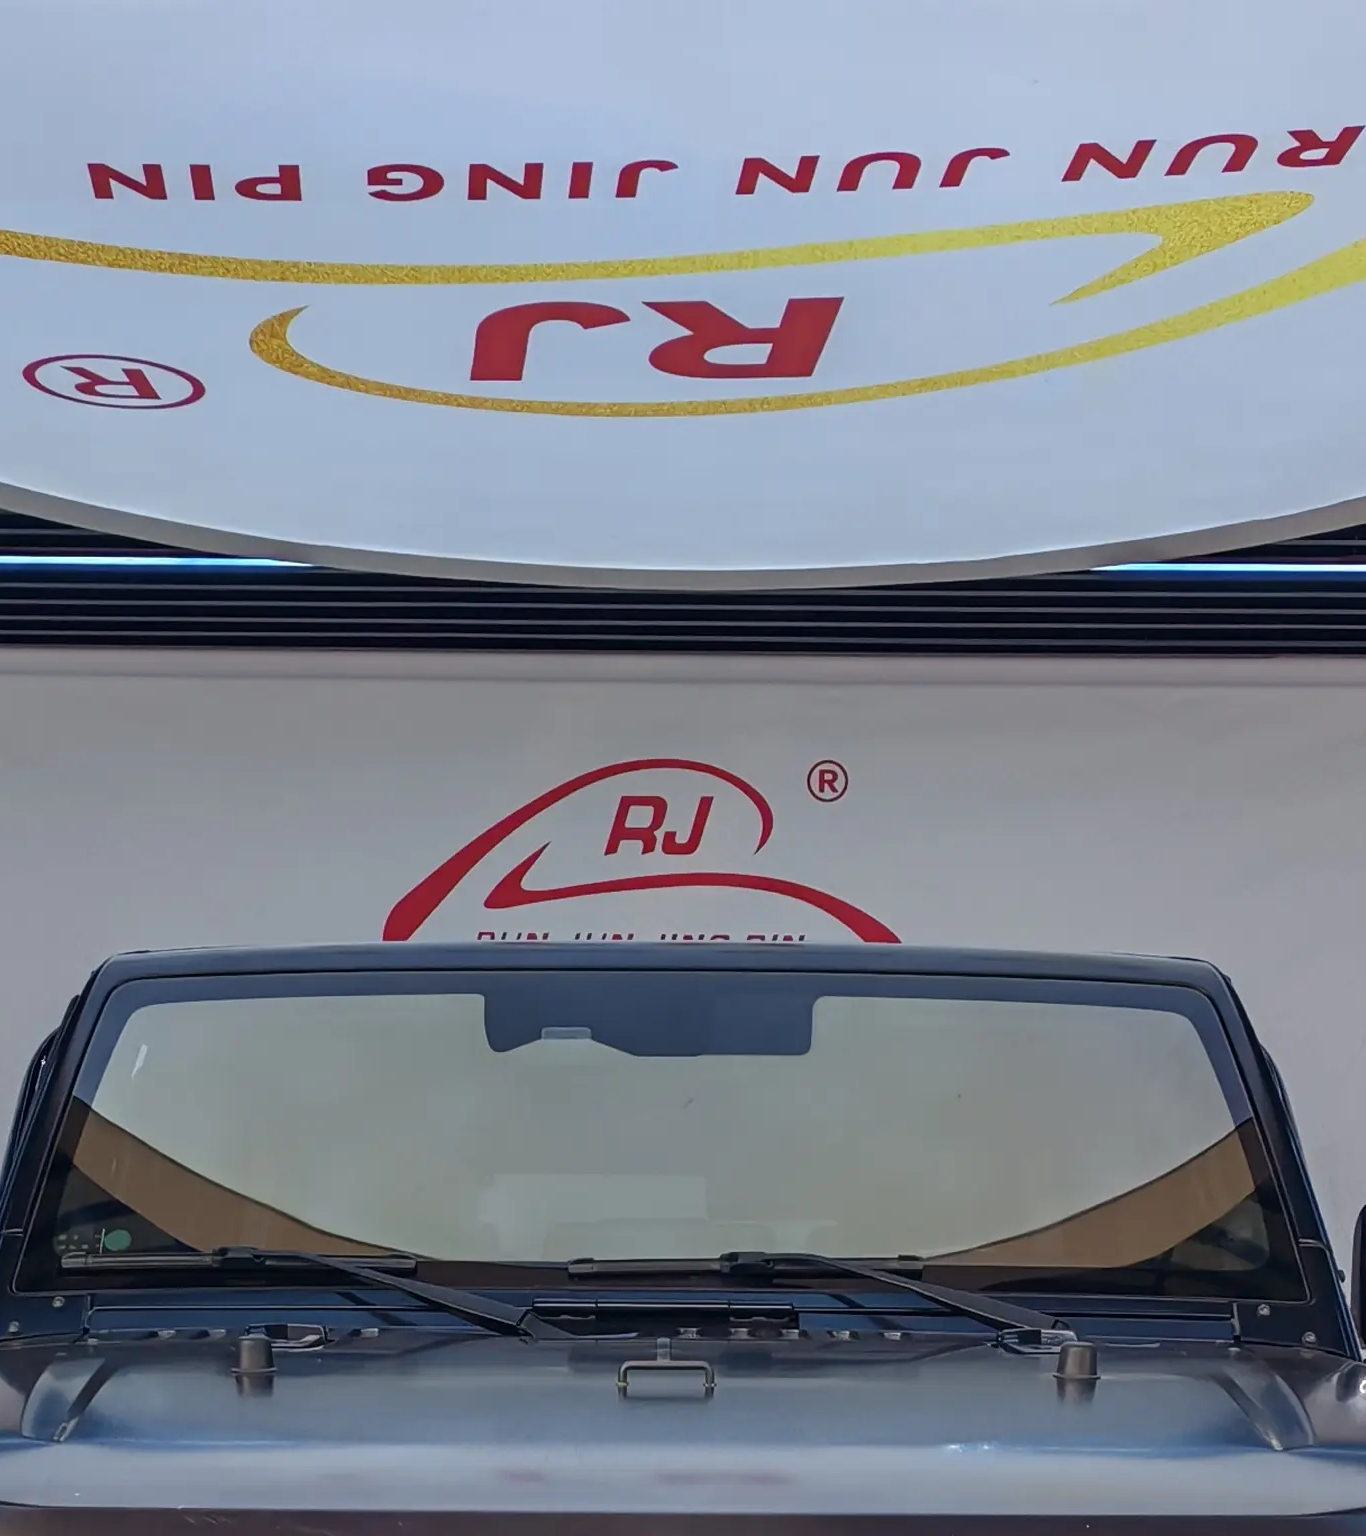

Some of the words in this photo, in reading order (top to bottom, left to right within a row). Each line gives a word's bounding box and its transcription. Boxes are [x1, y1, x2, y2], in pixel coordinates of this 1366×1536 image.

[735, 147, 1010, 195] JUN
[1060, 125, 1365, 182] RUN
[87, 163, 302, 202] PIN
[366, 160, 679, 202] JING
[469, 301, 845, 381] RJ
[603, 795, 714, 857] RJ
